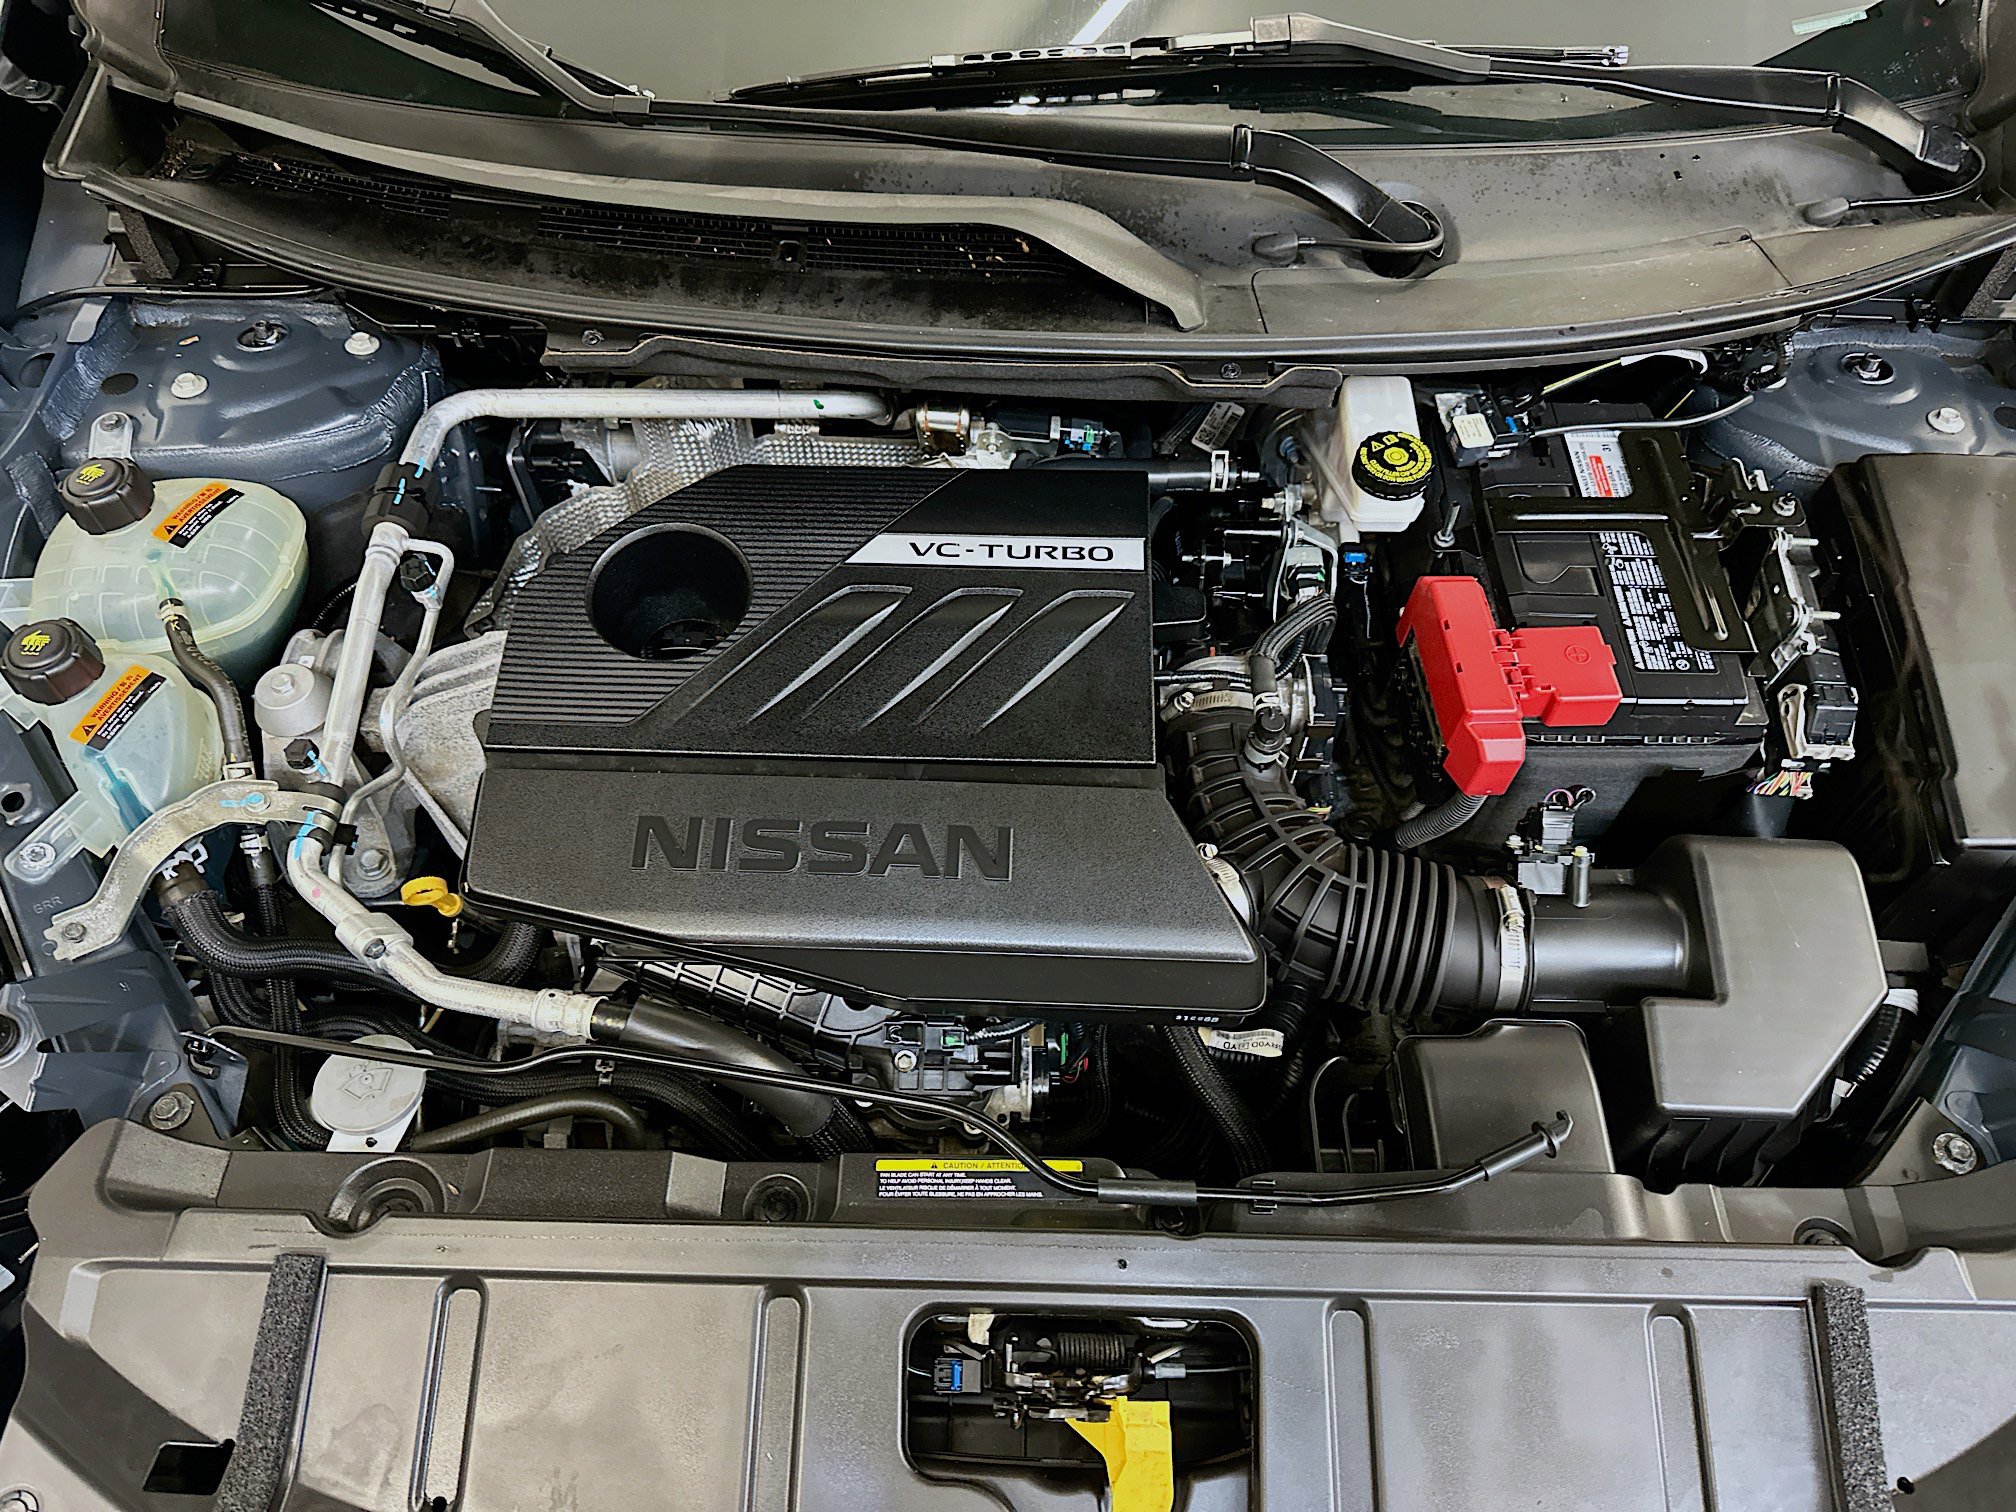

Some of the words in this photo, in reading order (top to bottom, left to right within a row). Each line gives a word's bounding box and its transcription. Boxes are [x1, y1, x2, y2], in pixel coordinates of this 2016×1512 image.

[1602, 444, 1611, 452] 31
[172, 499, 198, 520] WARNING
[178, 488, 220, 522] AVERTISSEMENT
[908, 542, 1114, 562] VC-TURBO
[91, 690, 118, 718] WARNING
[98, 674, 142, 721] AVERTISSEMENT
[631, 816, 1013, 881] NISSAN
